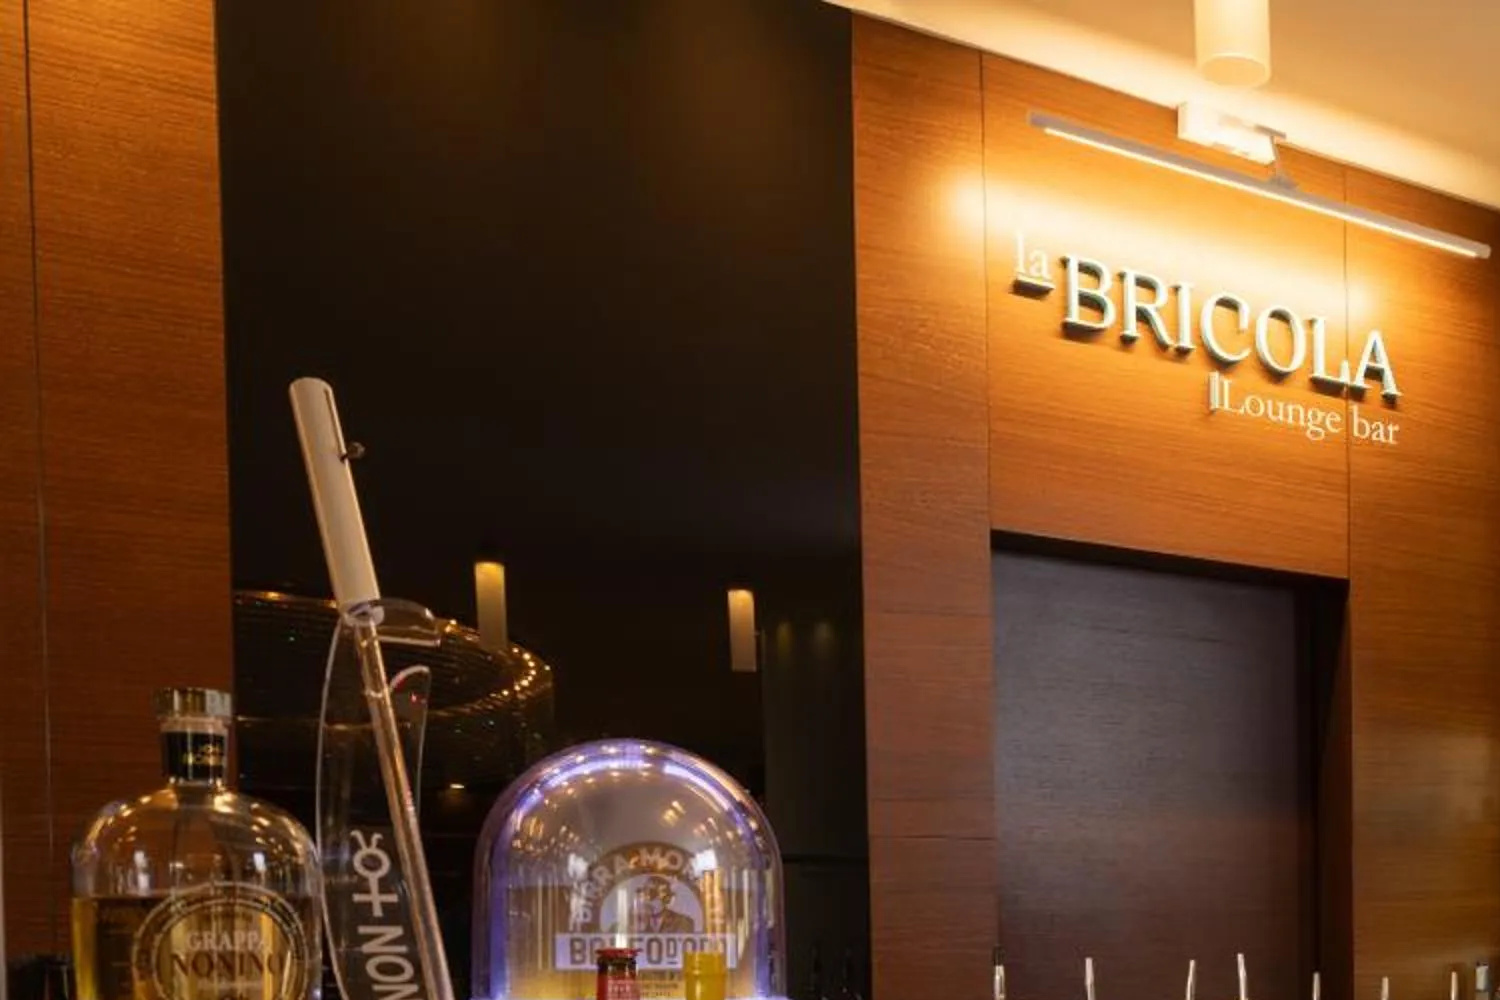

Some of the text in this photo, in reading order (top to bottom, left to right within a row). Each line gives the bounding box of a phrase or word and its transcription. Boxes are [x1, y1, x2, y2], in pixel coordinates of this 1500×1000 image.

[1012, 231, 1402, 403] la BRICOLA
[1221, 378, 1400, 445] Lounge bar
